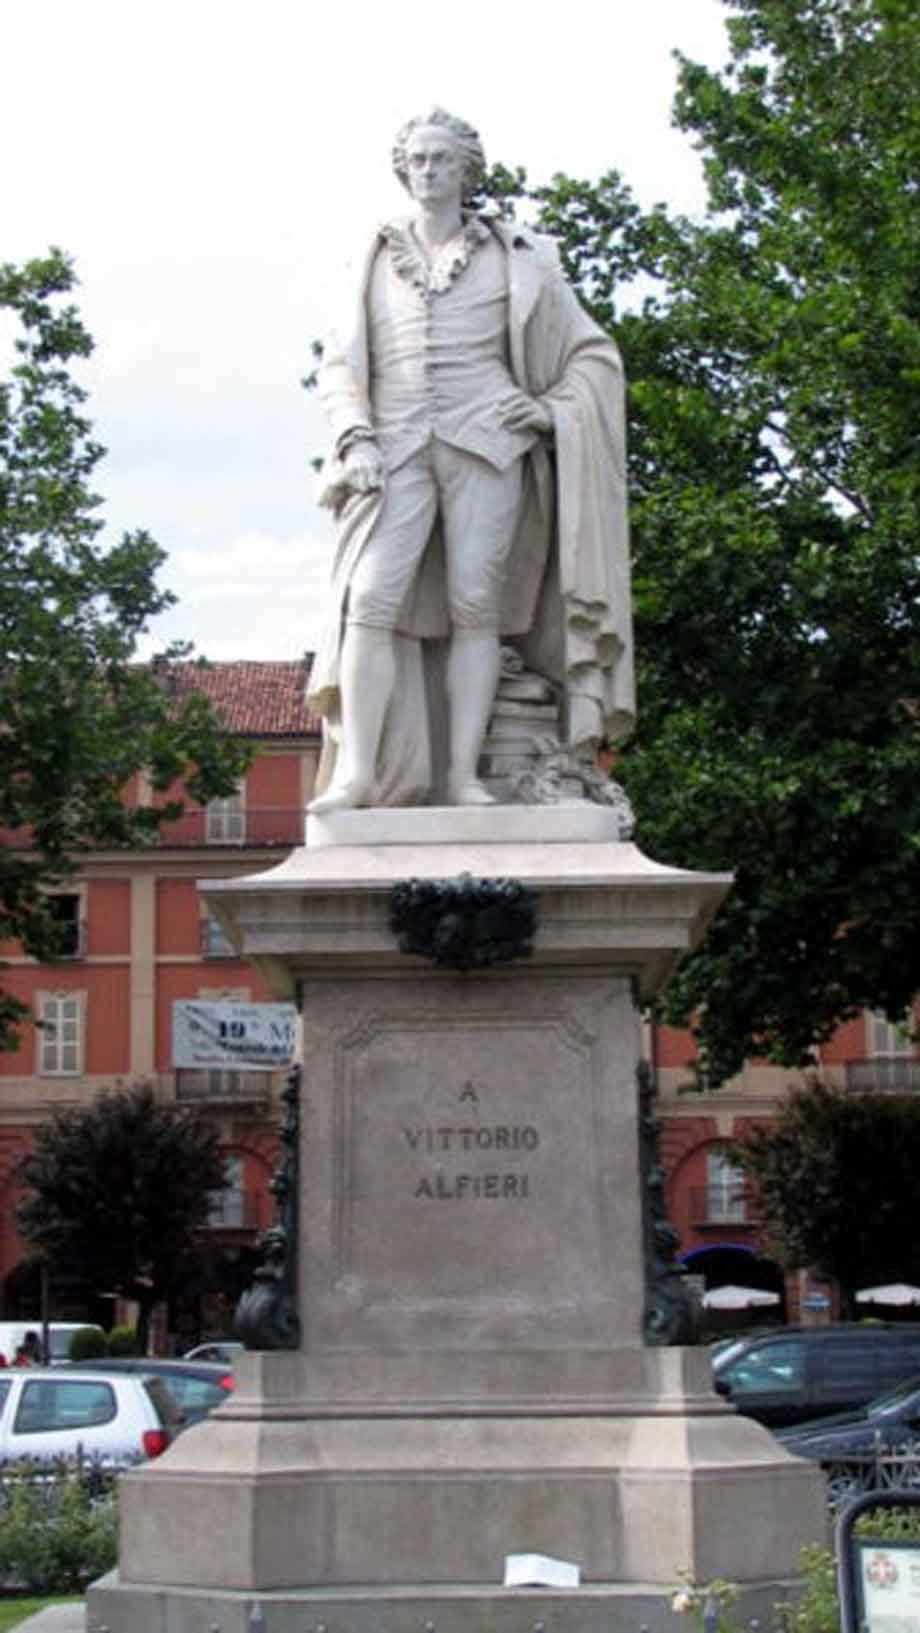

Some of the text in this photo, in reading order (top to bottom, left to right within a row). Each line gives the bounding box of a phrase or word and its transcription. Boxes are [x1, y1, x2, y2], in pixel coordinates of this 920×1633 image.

[458, 1080, 479, 1101] A
[403, 1125, 540, 1150] VITTORIO
[414, 1173, 529, 1199] ALFIERI
